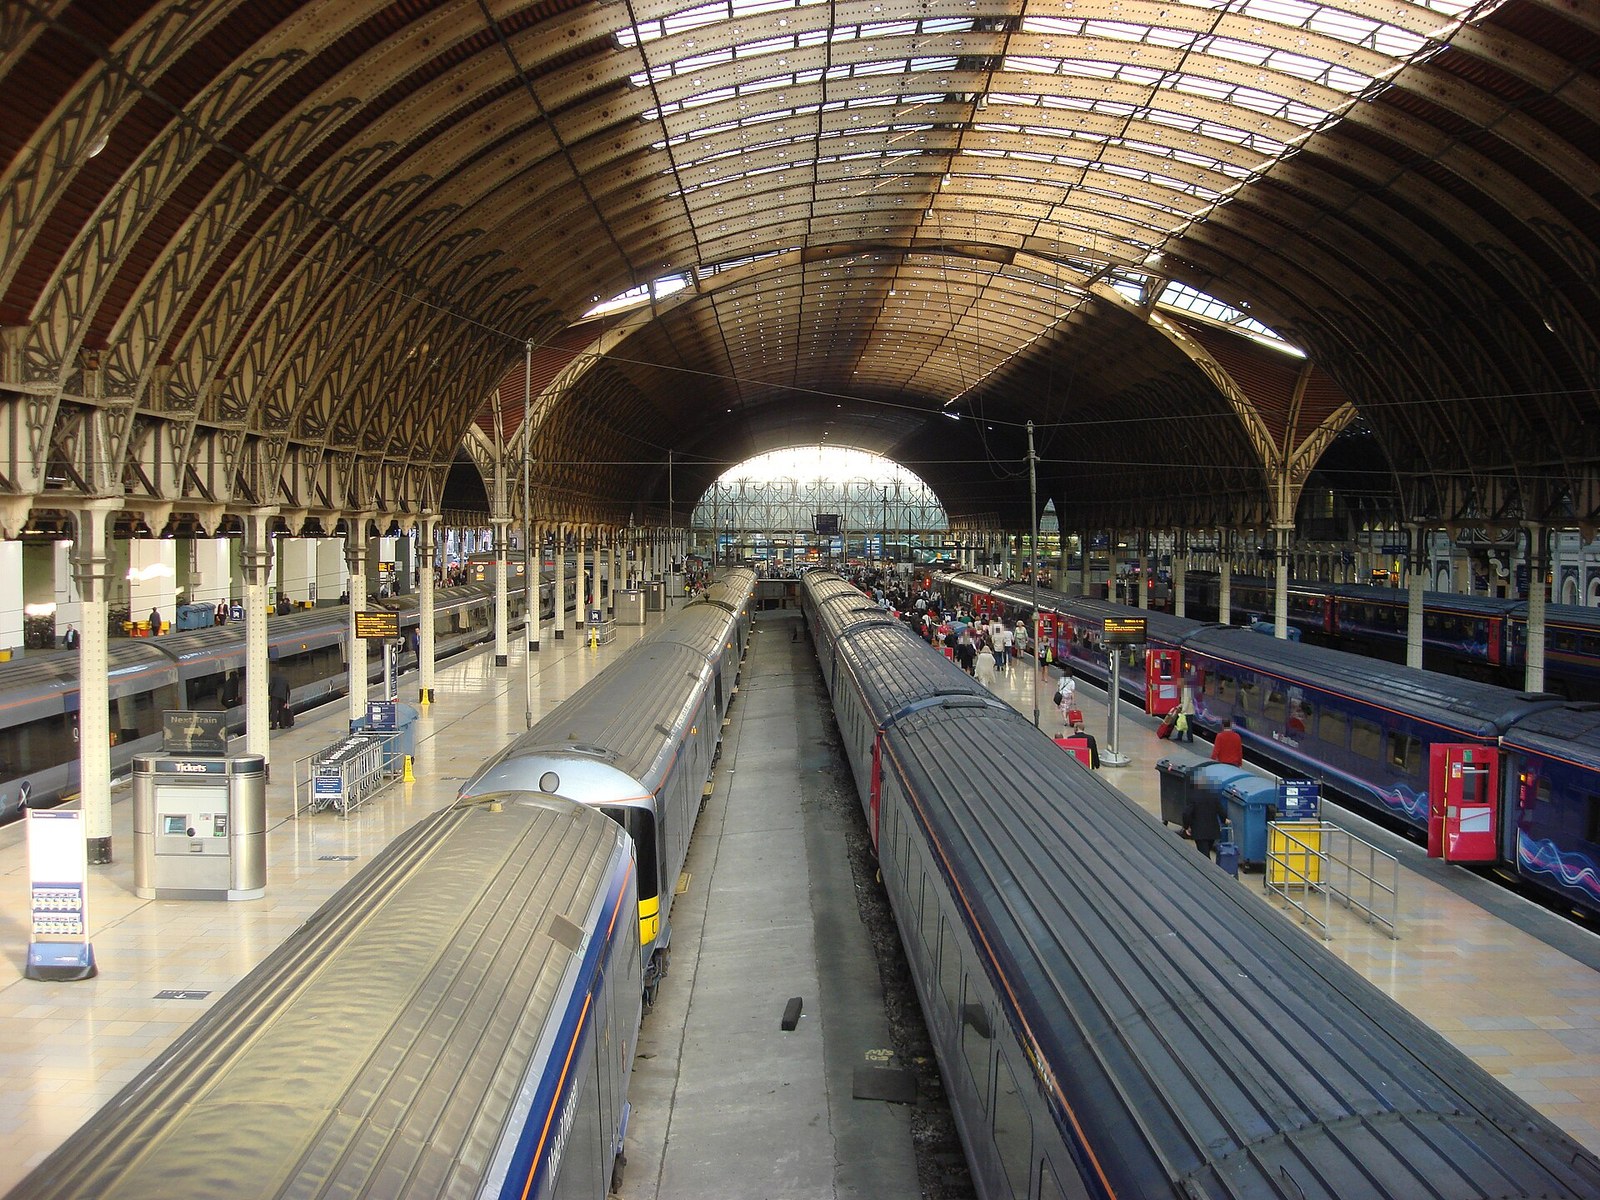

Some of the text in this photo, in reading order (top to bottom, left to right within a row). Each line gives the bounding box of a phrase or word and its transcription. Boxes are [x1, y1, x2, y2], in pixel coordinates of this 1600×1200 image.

[171, 716, 218, 724] Next Train
[175, 763, 207, 773] Tickets
